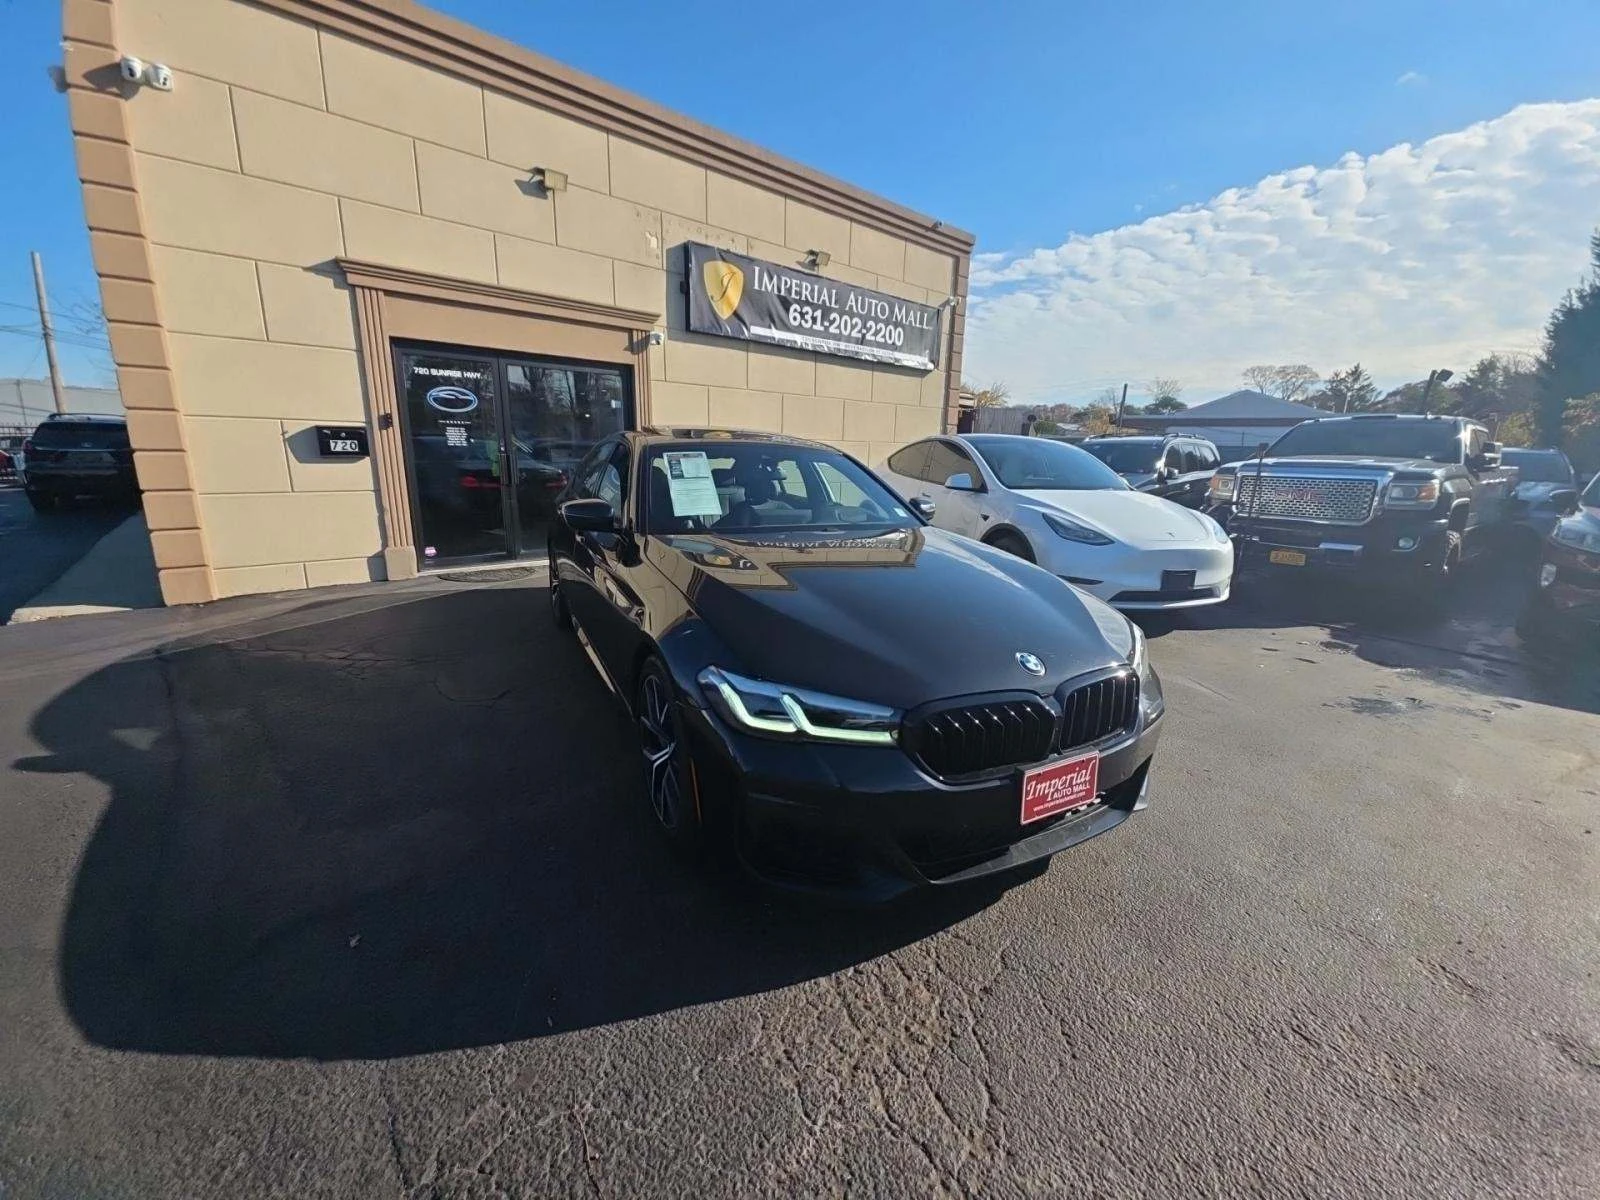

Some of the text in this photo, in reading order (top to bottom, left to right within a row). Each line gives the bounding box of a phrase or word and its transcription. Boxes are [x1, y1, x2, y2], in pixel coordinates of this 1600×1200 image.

[753, 266, 931, 329] IMPERIAL AUTO MALL
[788, 304, 904, 346] 631-202-2200
[413, 366, 429, 375] 720
[430, 368, 462, 377] SUNRISE
[332, 441, 357, 451] 720
[1026, 760, 1095, 801] Imperial
[1053, 782, 1090, 799] AUTO MALL
